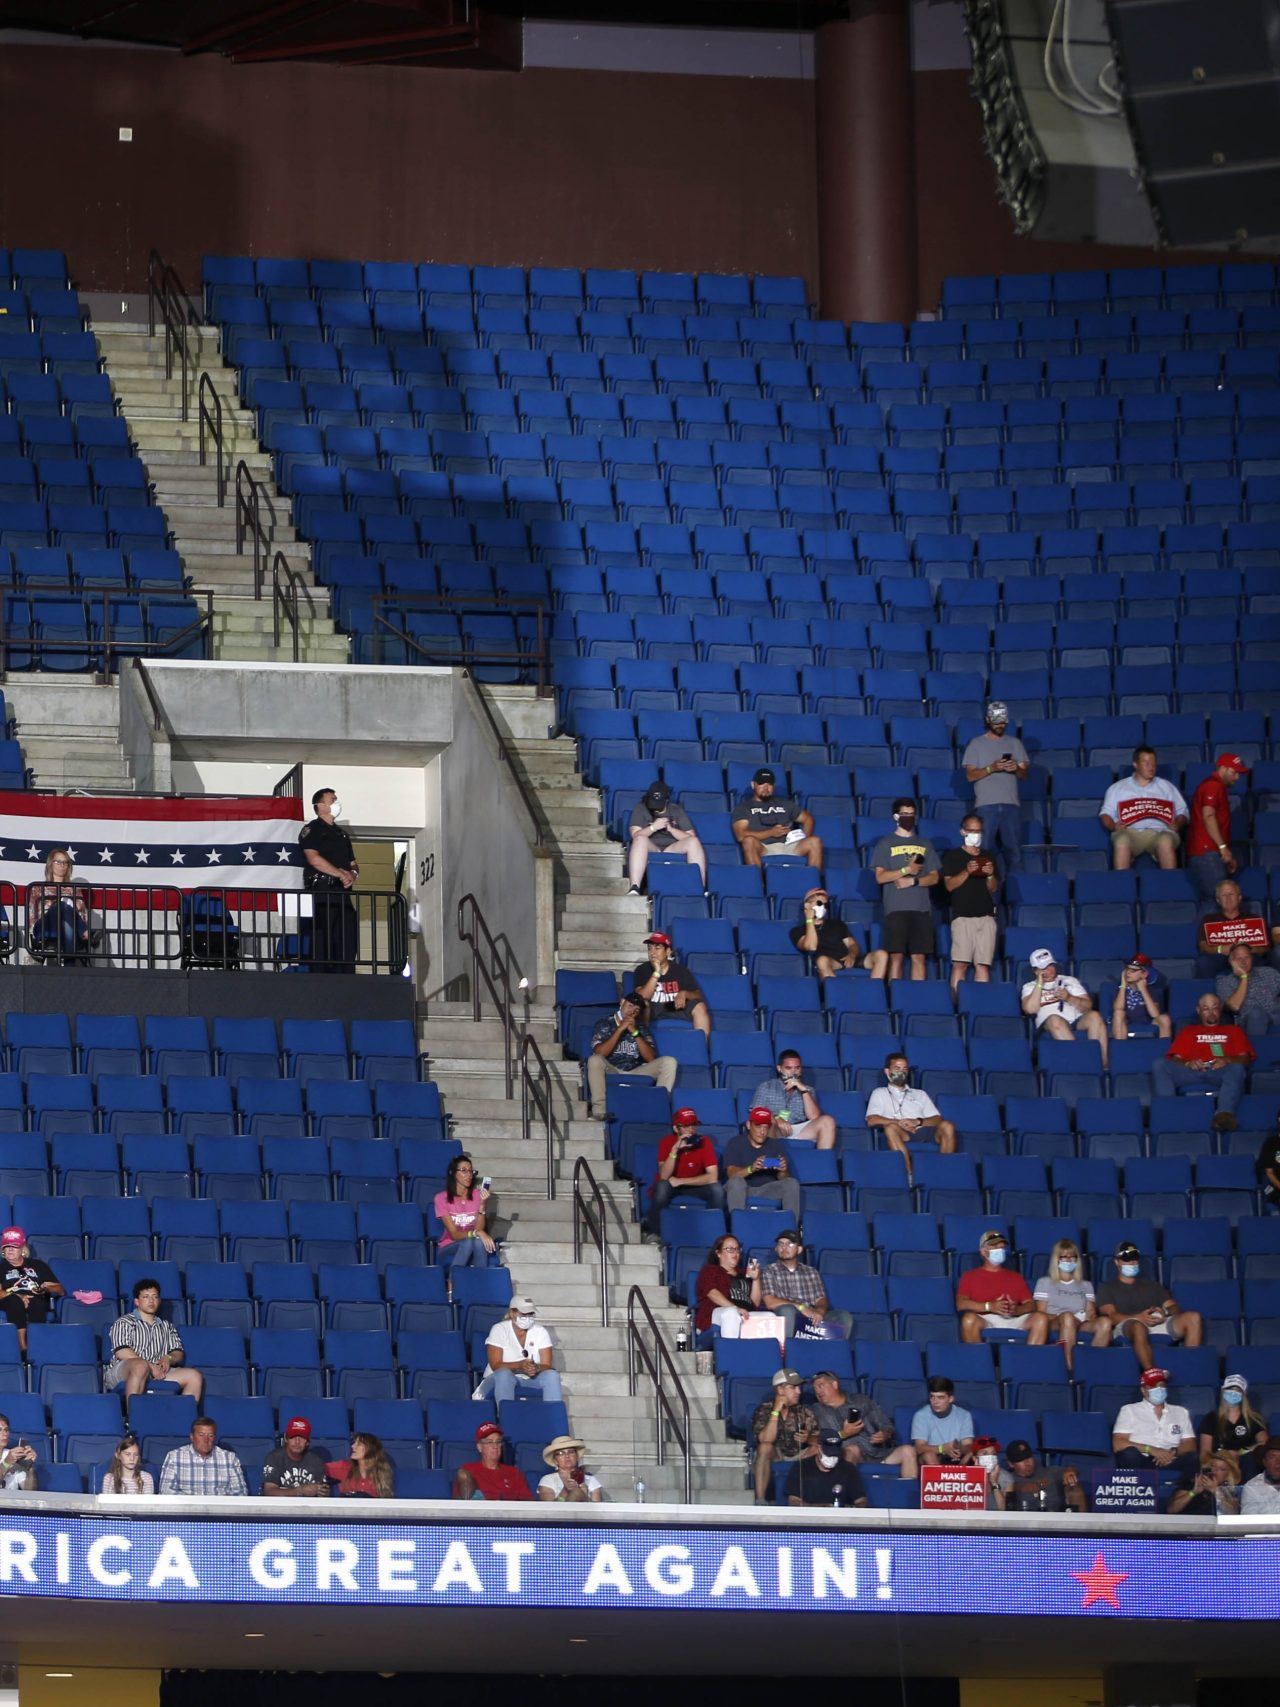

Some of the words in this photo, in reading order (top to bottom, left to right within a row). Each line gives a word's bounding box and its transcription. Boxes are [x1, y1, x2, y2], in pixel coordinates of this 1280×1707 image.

[1121, 804, 1172, 814] AMERICA
[1121, 809, 1146, 820] GREAT
[420, 852, 435, 886] 322
[1222, 923, 1246, 931] MAKE
[1209, 928, 1263, 938] AMERICA
[650, 991, 679, 1003] WHIT
[804, 1324, 826, 1336] MAKE
[940, 1472, 967, 1481] MAKE
[1111, 1476, 1139, 1484] MAKE
[924, 1481, 983, 1493] AMERICA
[1095, 1485, 1154, 1497] AMERICA
[923, 1494, 953, 1503] GREAT
[954, 1494, 983, 1503] AGAIN
[1095, 1497, 1125, 1506] GREAT
[1125, 1498, 1155, 1507] AGAIN
[247, 1537, 537, 1593] GREAT
[582, 1543, 893, 1600] AGAIN!
